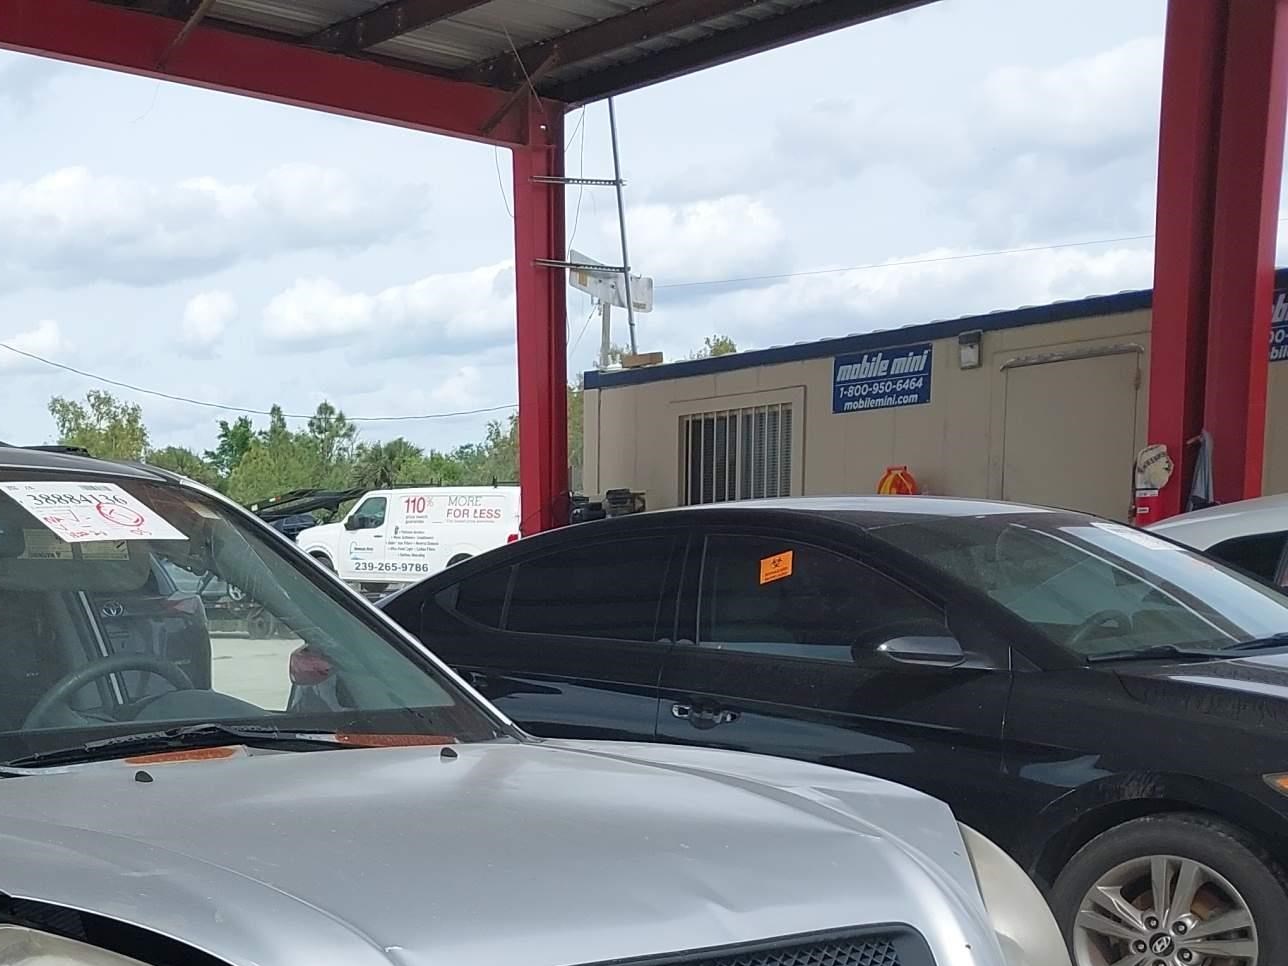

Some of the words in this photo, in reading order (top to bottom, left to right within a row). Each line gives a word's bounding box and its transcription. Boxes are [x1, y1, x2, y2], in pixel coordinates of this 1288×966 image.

[836, 352, 890, 382] mobile
[890, 349, 929, 375] mini
[839, 377, 924, 398] 1-800-950-6464
[843, 393, 919, 411] mobilemini.com
[26, 493, 128, 506] 38884136
[447, 495, 483, 507] MORE
[446, 508, 470, 519] FOR
[473, 508, 502, 519] LESS
[354, 562, 429, 572] 239-265-9786
